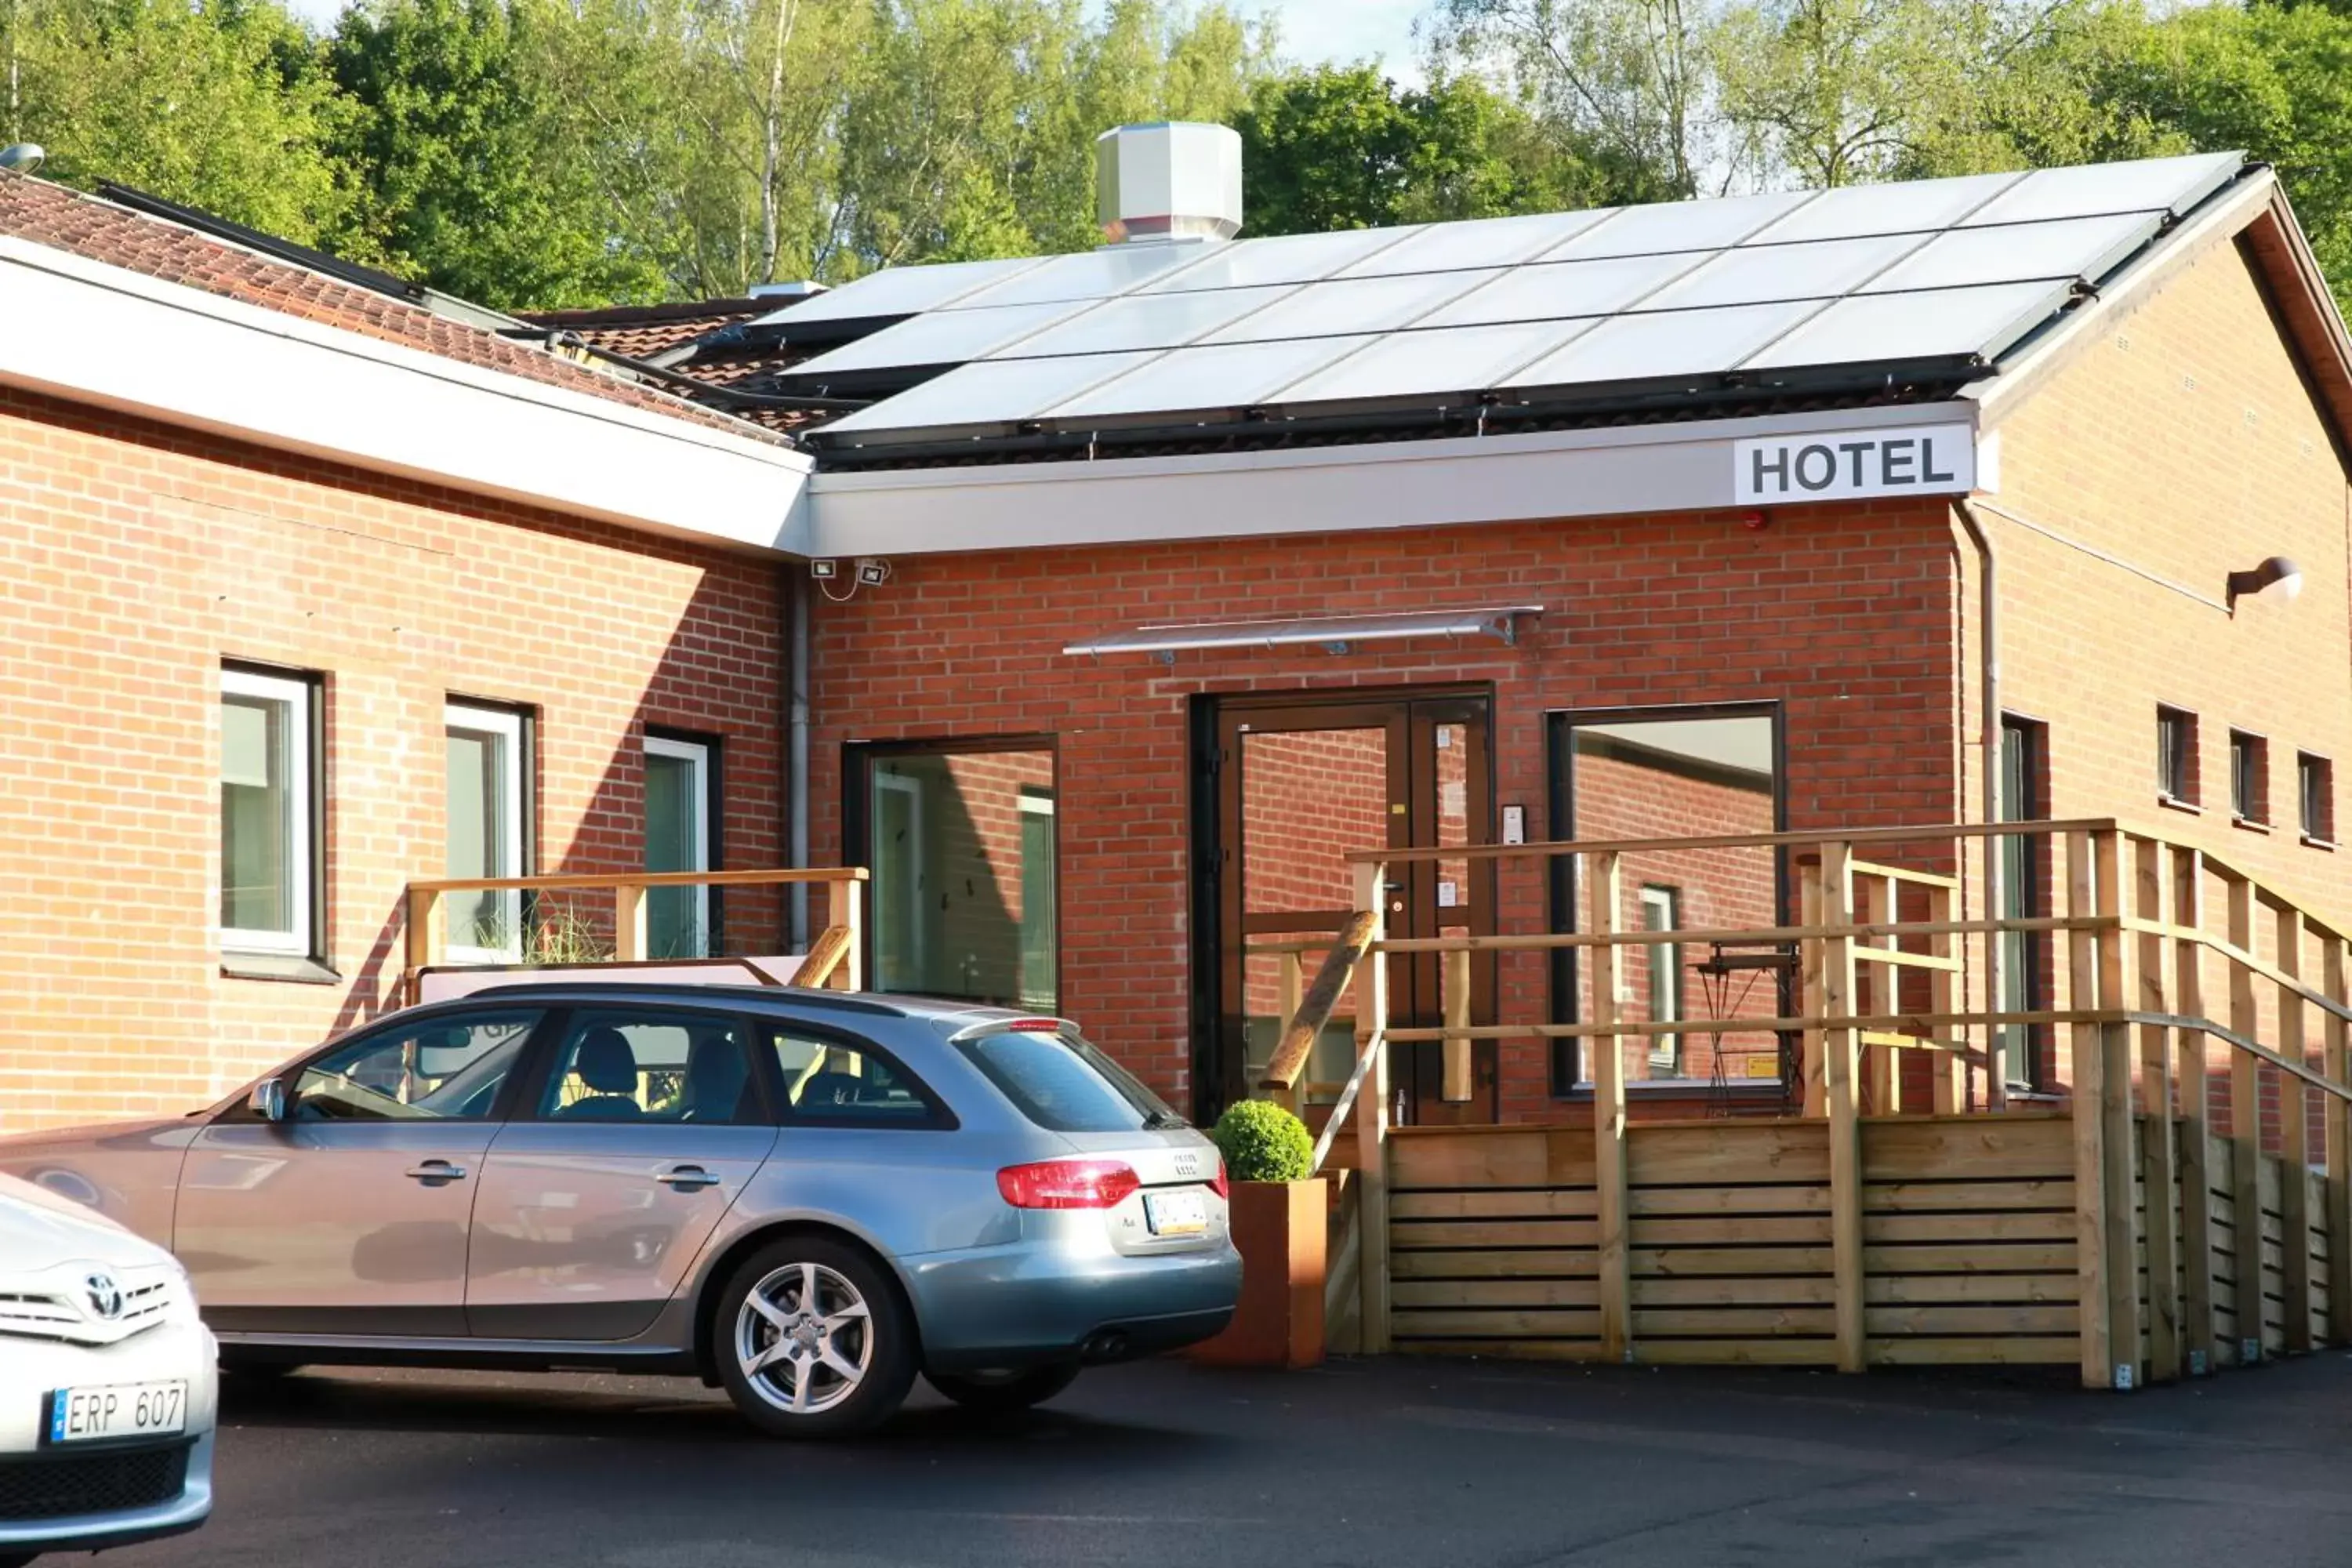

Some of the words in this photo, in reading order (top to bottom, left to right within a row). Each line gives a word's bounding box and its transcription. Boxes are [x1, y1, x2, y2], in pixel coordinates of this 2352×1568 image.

[1752, 437, 1955, 493] HOTEL
[69, 1393, 118, 1434] ERP
[135, 1388, 180, 1427] 607
